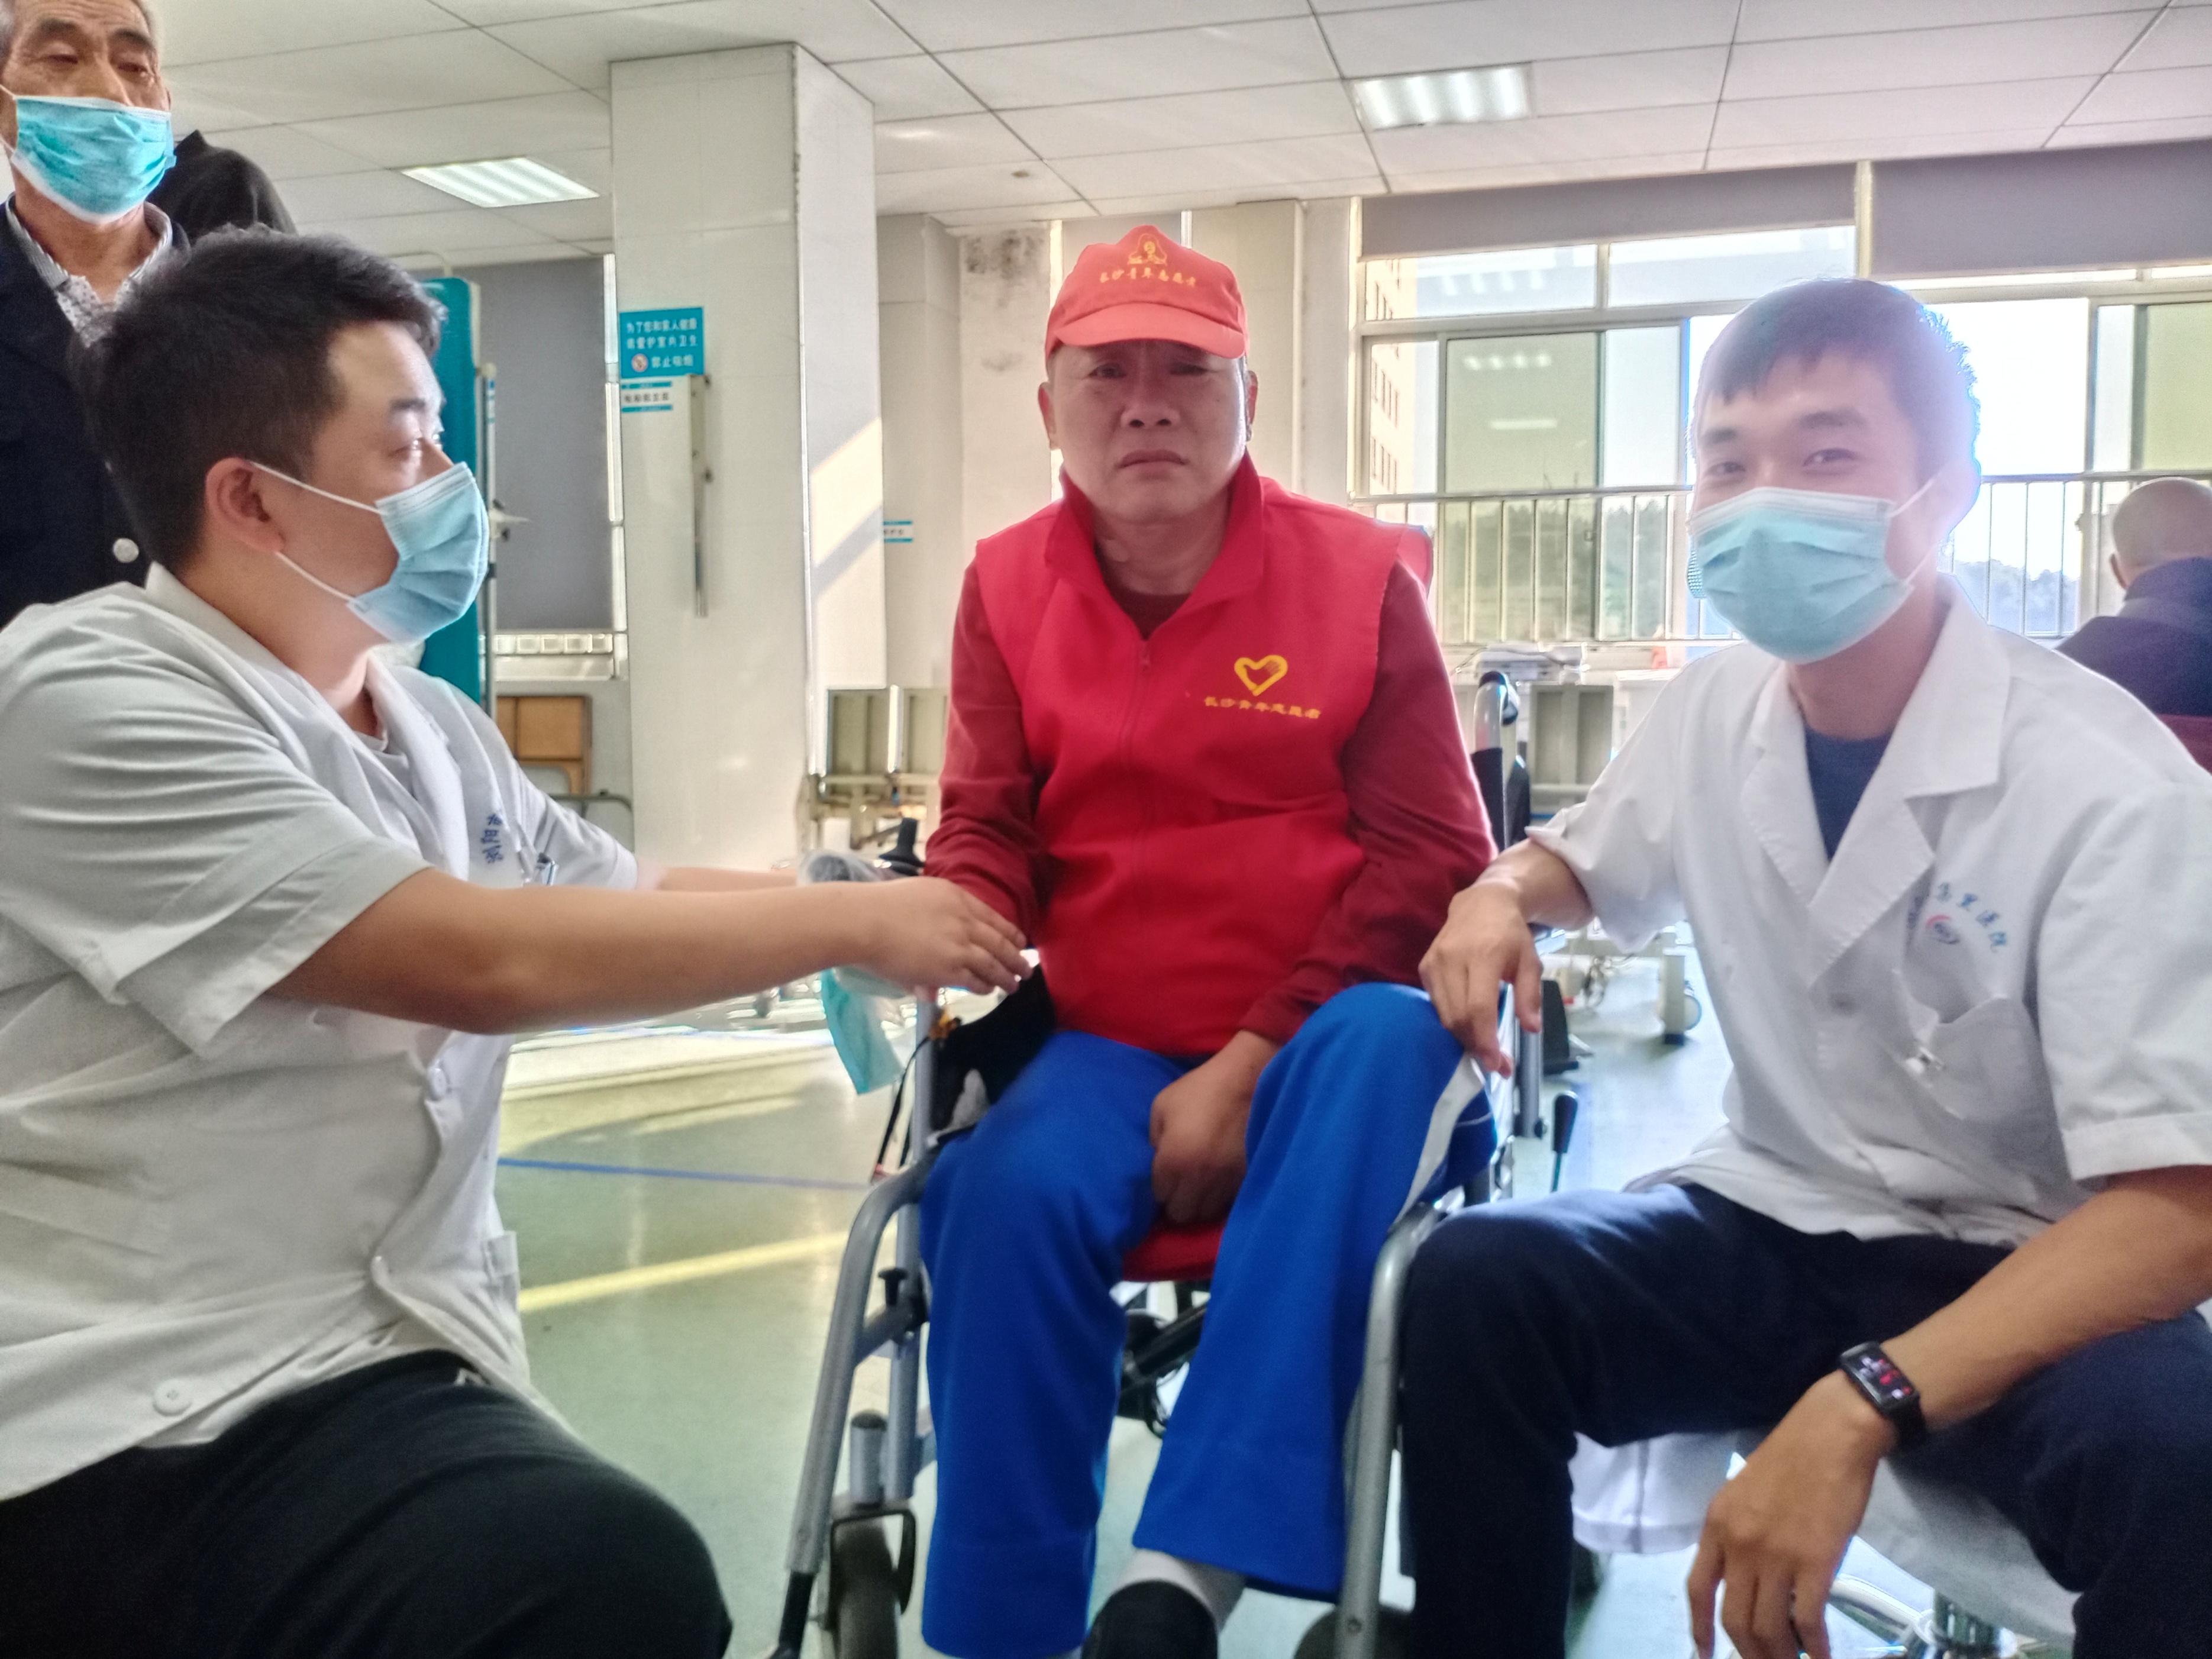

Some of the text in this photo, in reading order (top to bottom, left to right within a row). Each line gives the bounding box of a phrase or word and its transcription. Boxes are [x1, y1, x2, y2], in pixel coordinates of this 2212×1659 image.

[627, 318, 697, 334] 为了您和家人健康
[627, 335, 698, 349] 请爱护室内卫生
[652, 354, 693, 368] 禁止吸烟
